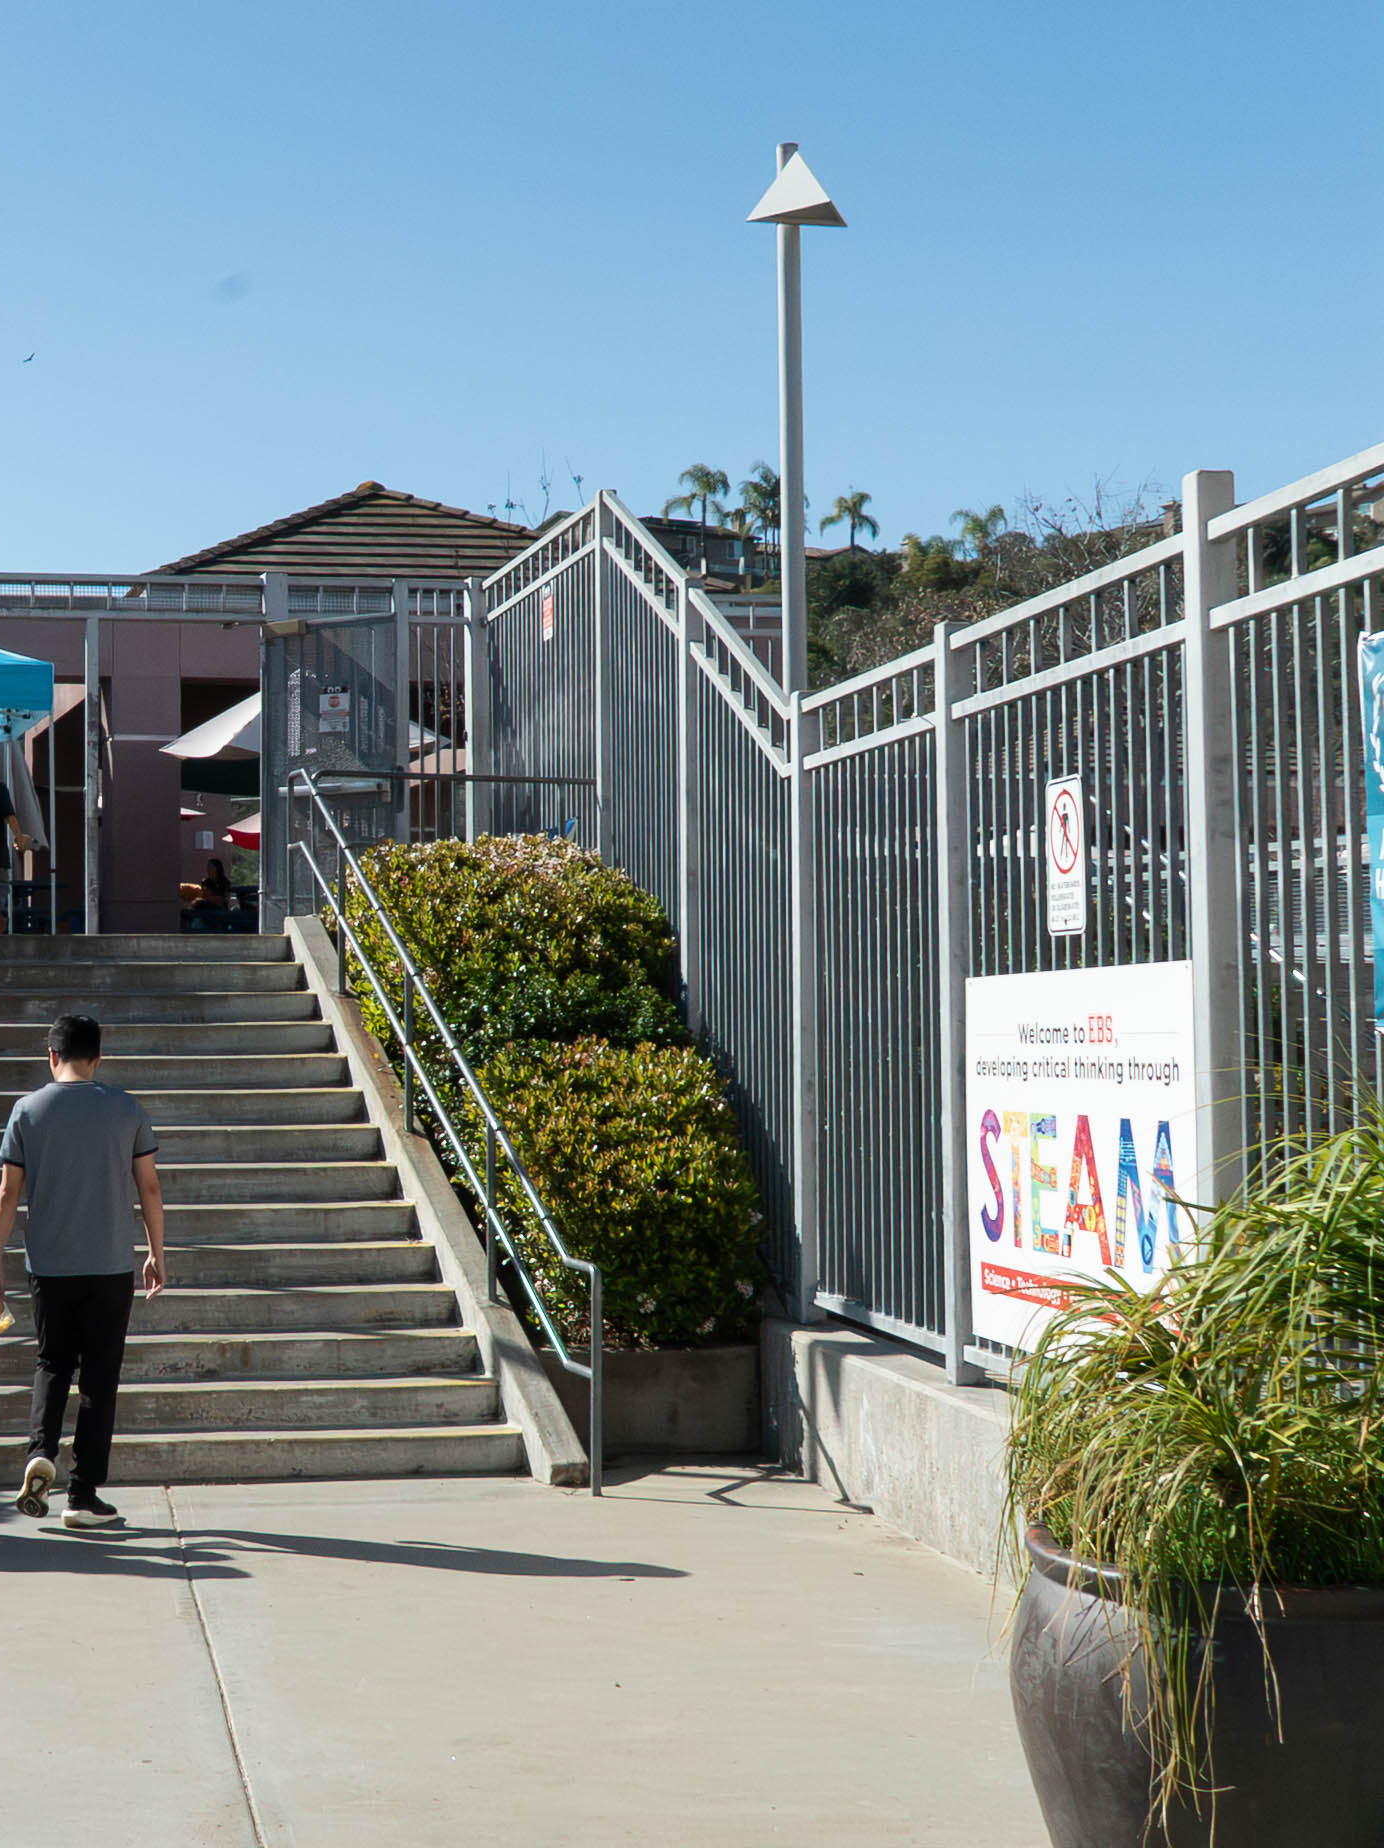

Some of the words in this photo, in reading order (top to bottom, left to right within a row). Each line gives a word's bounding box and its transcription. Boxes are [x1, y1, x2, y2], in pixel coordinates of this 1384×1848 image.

[1018, 1022, 1070, 1044] Welcome
[1073, 1024, 1086, 1044] to
[976, 1056, 1028, 1081] developing
[1032, 1056, 1070, 1078] critical
[1074, 1056, 1124, 1085] thinking
[1128, 1056, 1180, 1087] through
[980, 1109, 1184, 1274] STEAM
